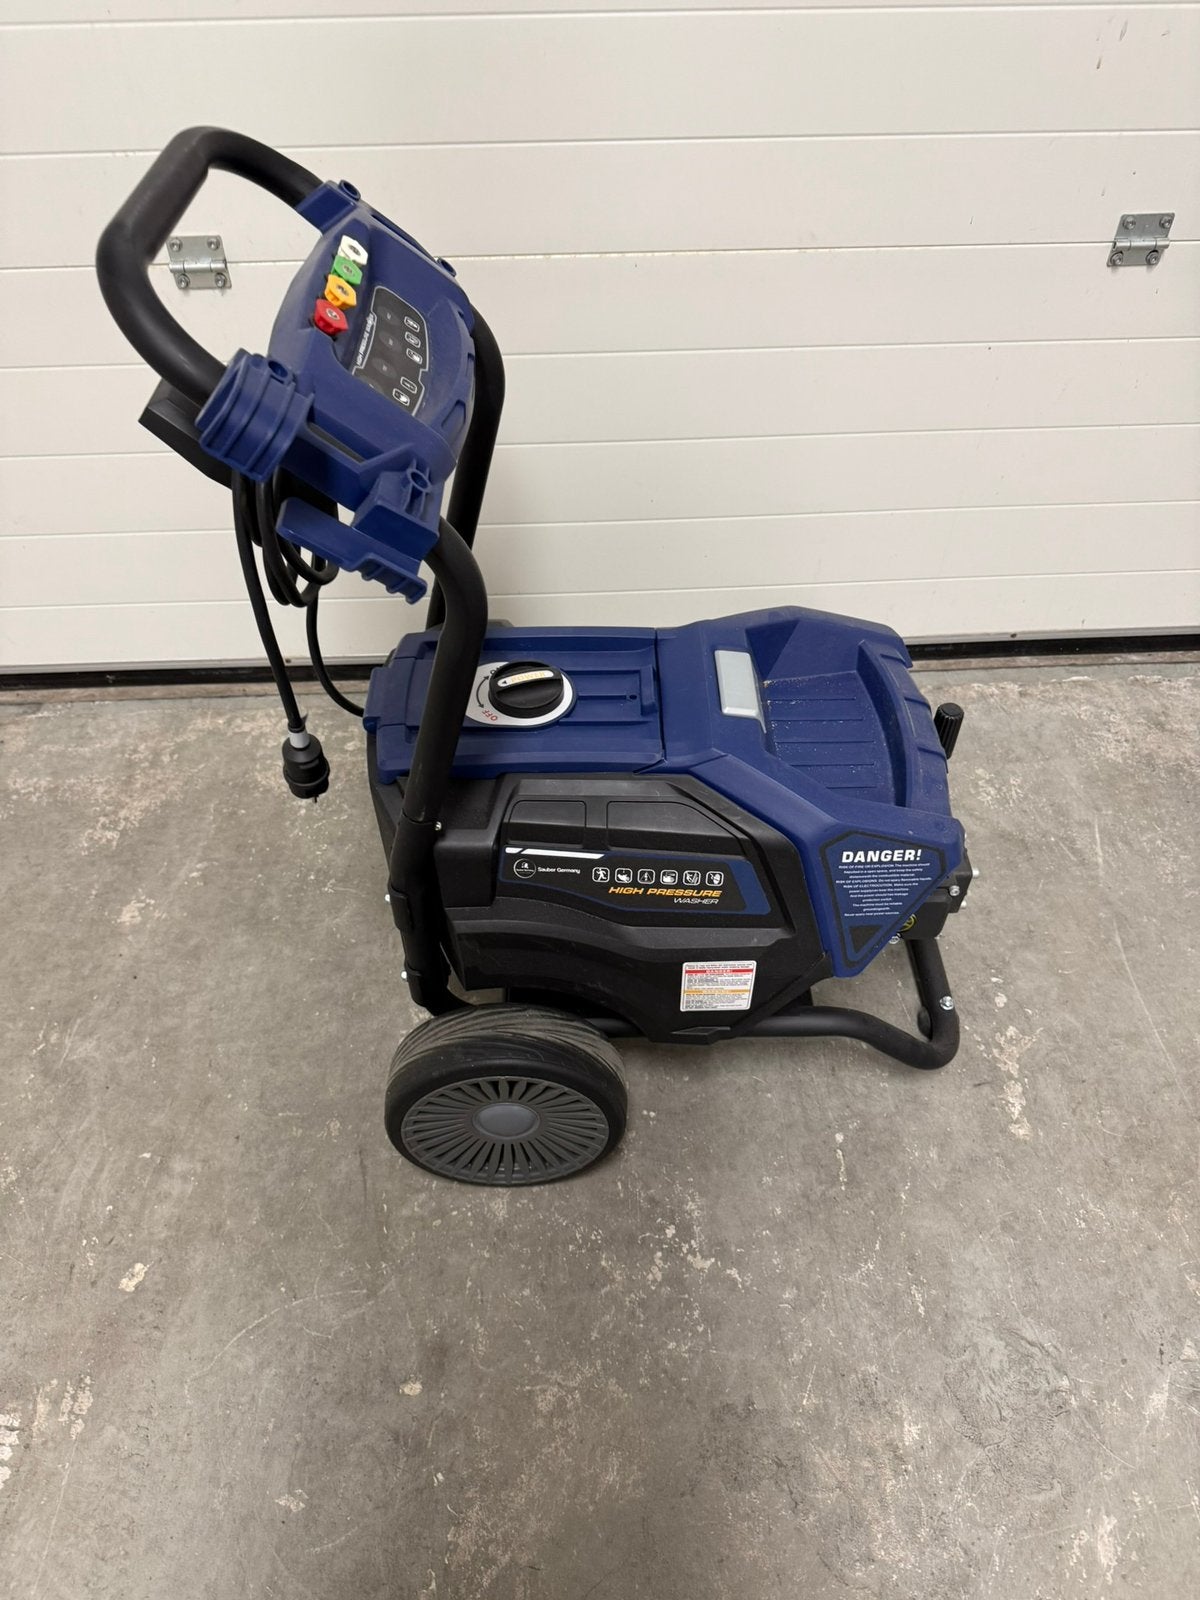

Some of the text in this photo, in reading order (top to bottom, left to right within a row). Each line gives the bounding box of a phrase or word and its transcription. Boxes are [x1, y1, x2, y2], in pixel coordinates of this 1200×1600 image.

[482, 710, 498, 720] OFF
[842, 849, 922, 862] DANGER!
[608, 886, 722, 898] HIGH PRESSURE
